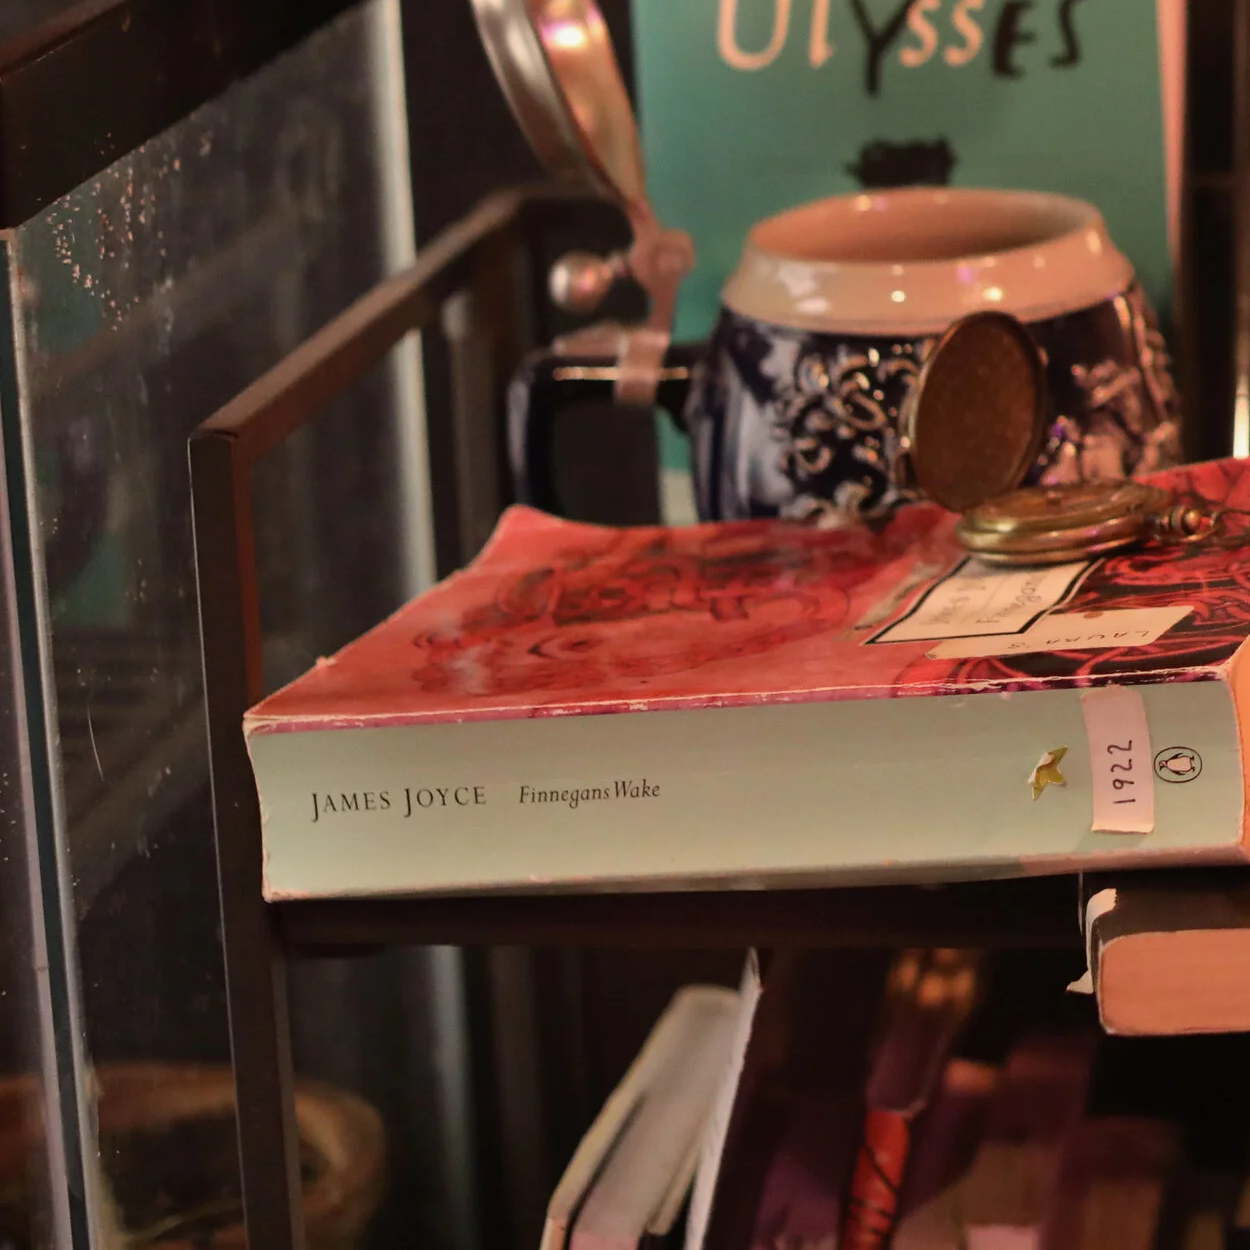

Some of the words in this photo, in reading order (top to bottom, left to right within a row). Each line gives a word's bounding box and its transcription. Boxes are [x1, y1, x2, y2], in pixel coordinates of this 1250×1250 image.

[1106, 739, 1136, 804] 1922
[311, 791, 391, 823] JAMES
[404, 785, 487, 818] JOYCE
[518, 784, 610, 809] Finnegans
[614, 779, 661, 800] Wake
